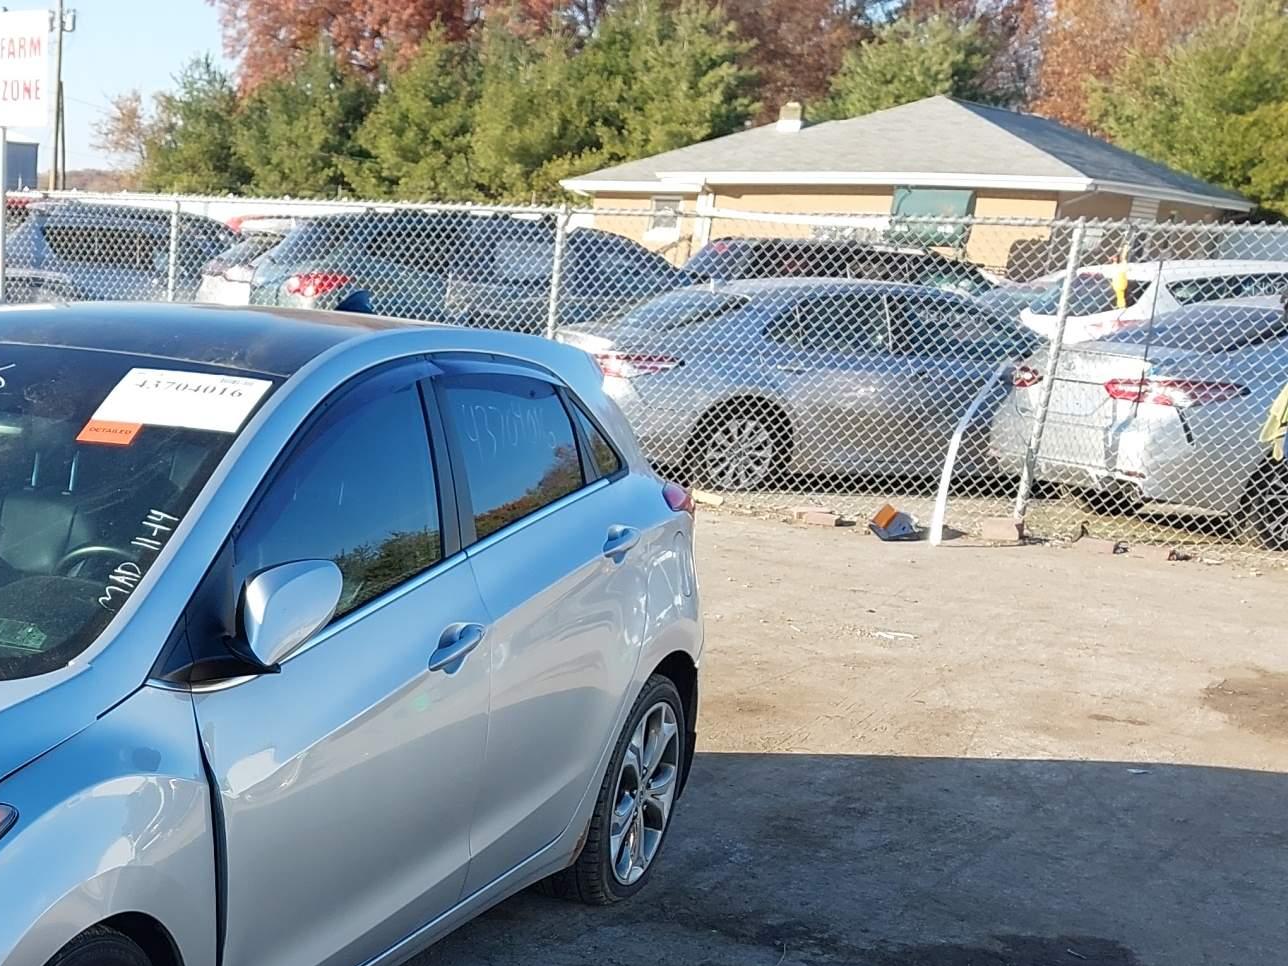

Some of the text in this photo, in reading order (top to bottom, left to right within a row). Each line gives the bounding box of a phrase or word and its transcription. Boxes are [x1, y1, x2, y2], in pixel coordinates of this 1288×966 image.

[0, 36, 41, 60] FARM
[2, 79, 41, 102] ZONE
[136, 379, 243, 398] 43704016
